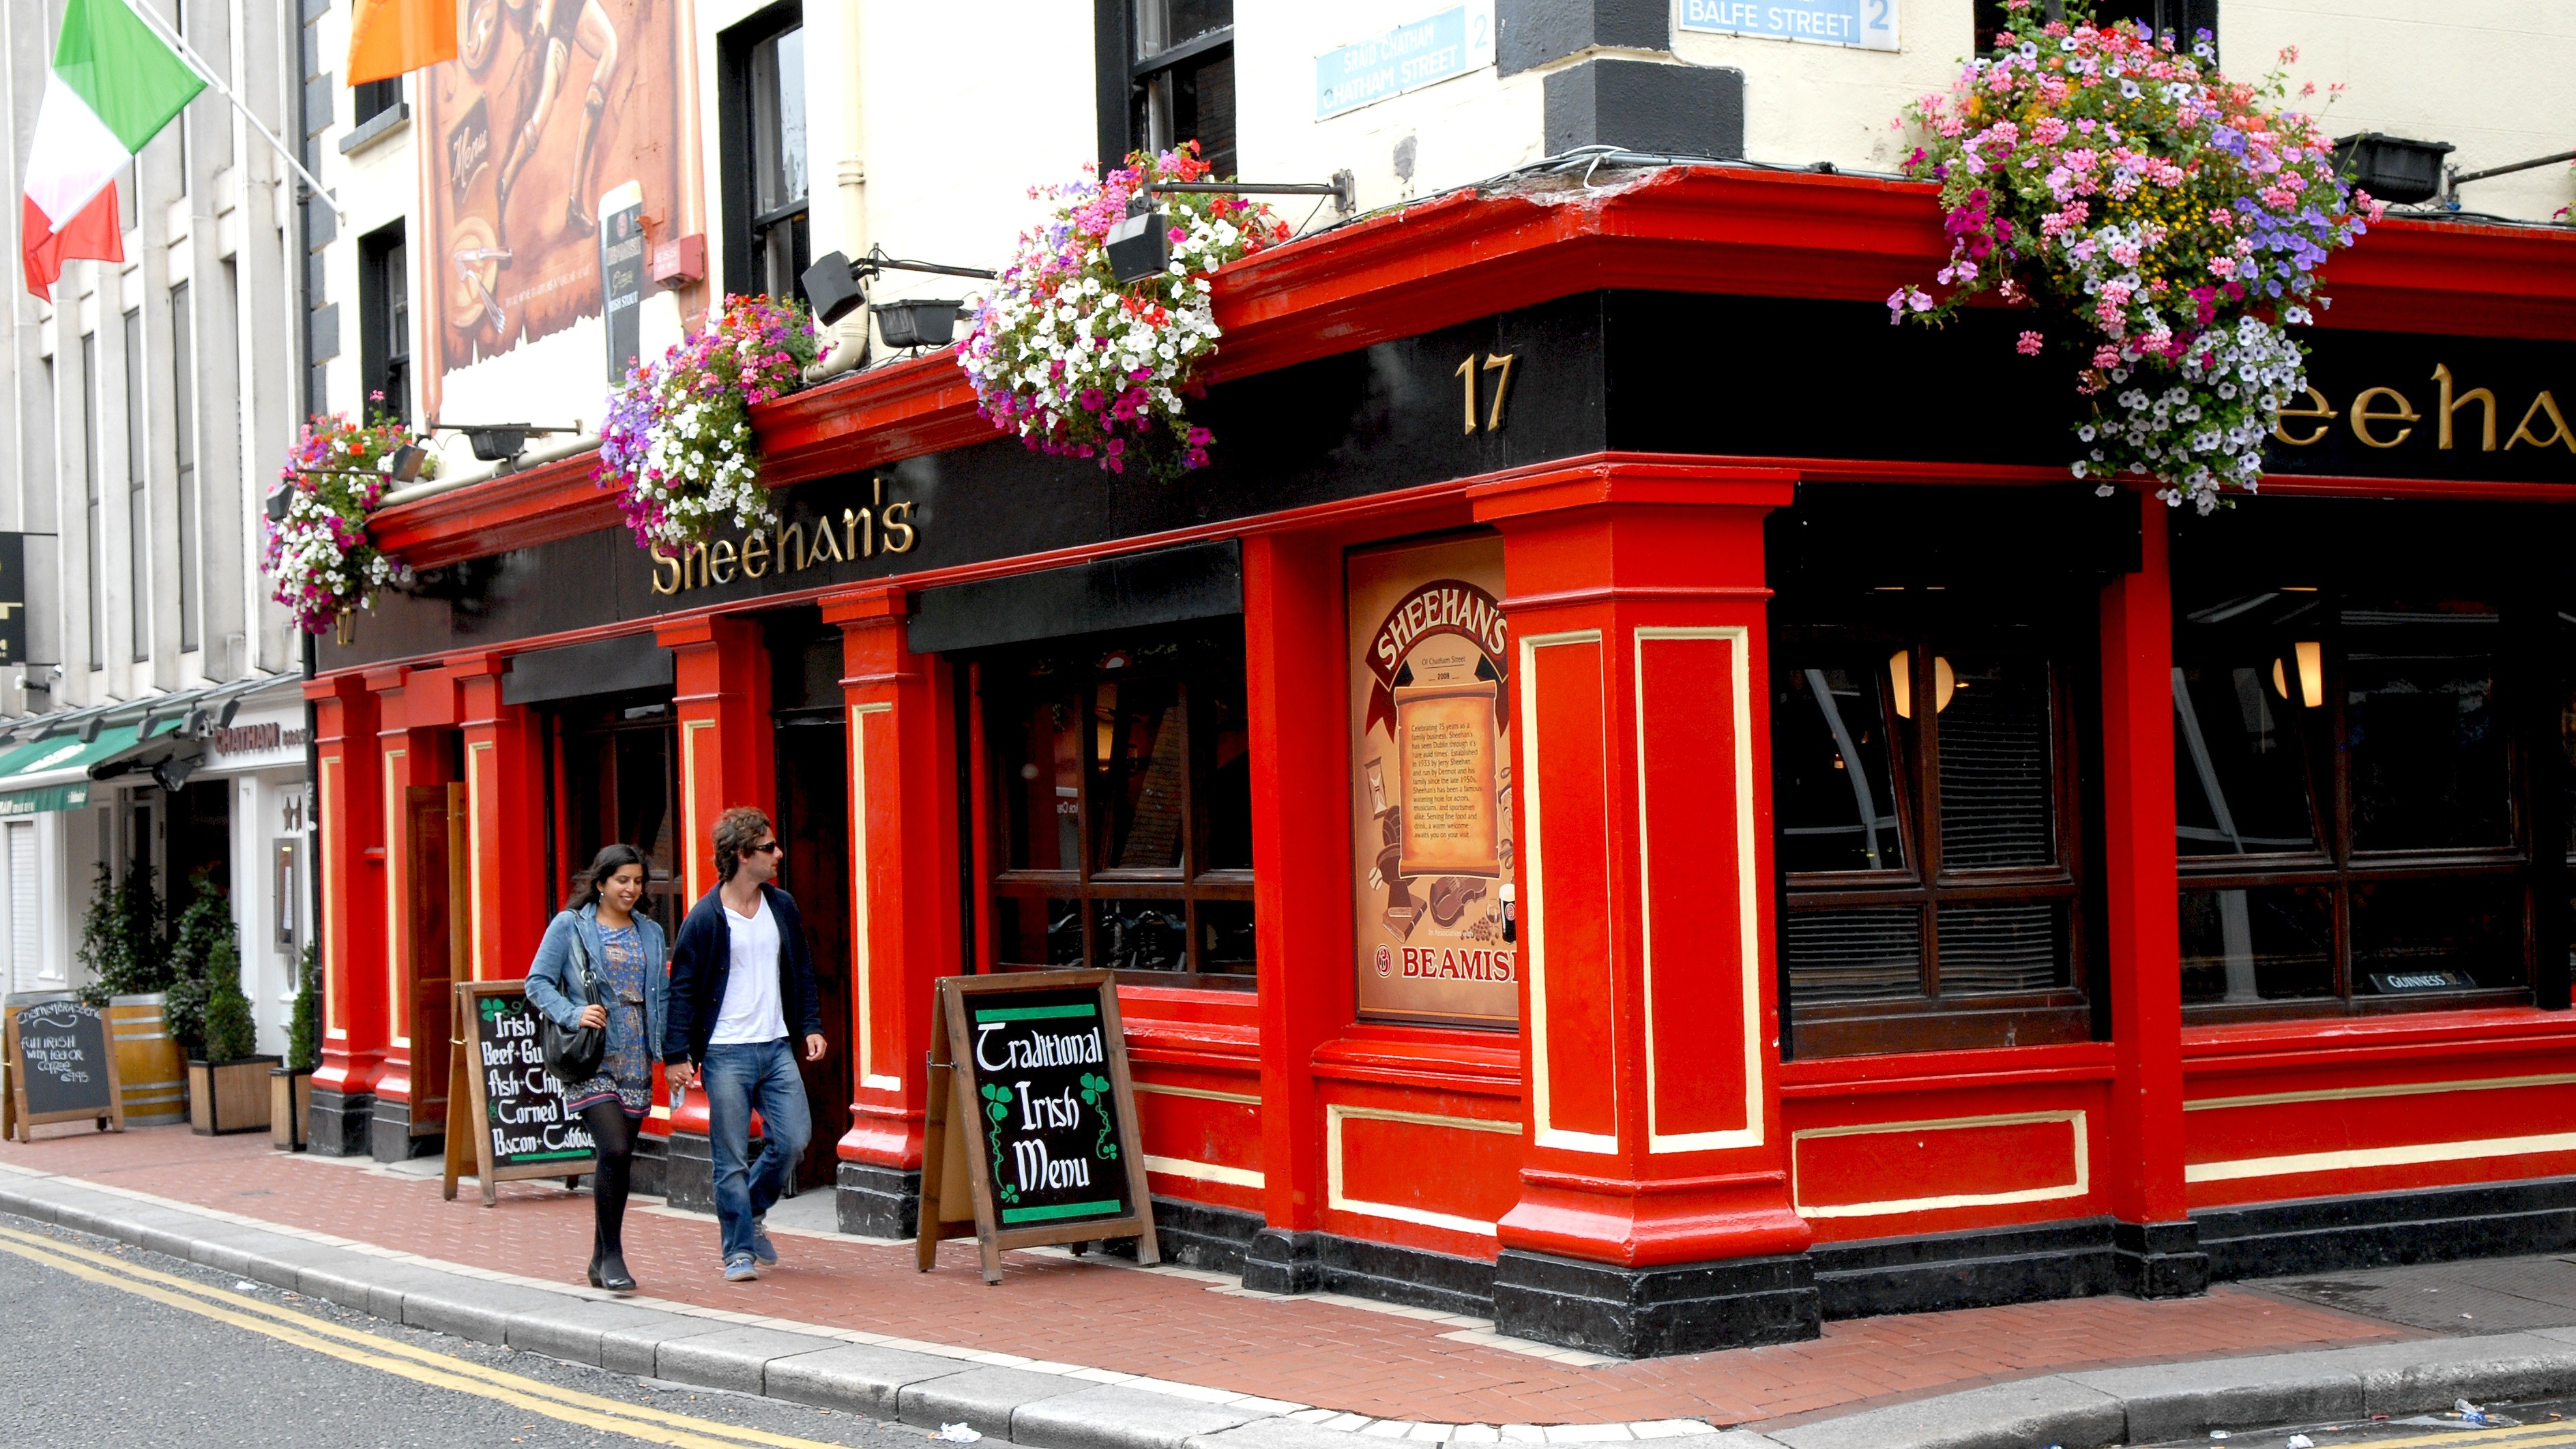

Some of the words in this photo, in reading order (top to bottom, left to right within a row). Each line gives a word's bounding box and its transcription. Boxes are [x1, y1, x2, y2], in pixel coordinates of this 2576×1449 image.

[1381, 23, 1435, 61] CHATHAM
[1474, 14, 1488, 49] 2
[1688, 1, 1758, 28] BALFE
[1768, 8, 1853, 37] STREET
[1869, 0, 1889, 30] 2
[1322, 66, 1394, 111] CHATHAM
[1401, 44, 1459, 85] STREET
[451, 126, 488, 188] Menu
[1454, 353, 1514, 435] 17
[1377, 588, 1507, 671] SHEEHAN'S
[215, 722, 280, 756] CHATHAM
[1401, 946, 1519, 983] BEAMIS
[2388, 975, 2446, 988] GUINNESS
[495, 1012, 536, 1038] Irish
[976, 1022, 1103, 1071] Traditional
[498, 1100, 558, 1125] Corned
[1015, 1081, 1079, 1130] Irish
[1013, 1138, 1091, 1192] Menu
